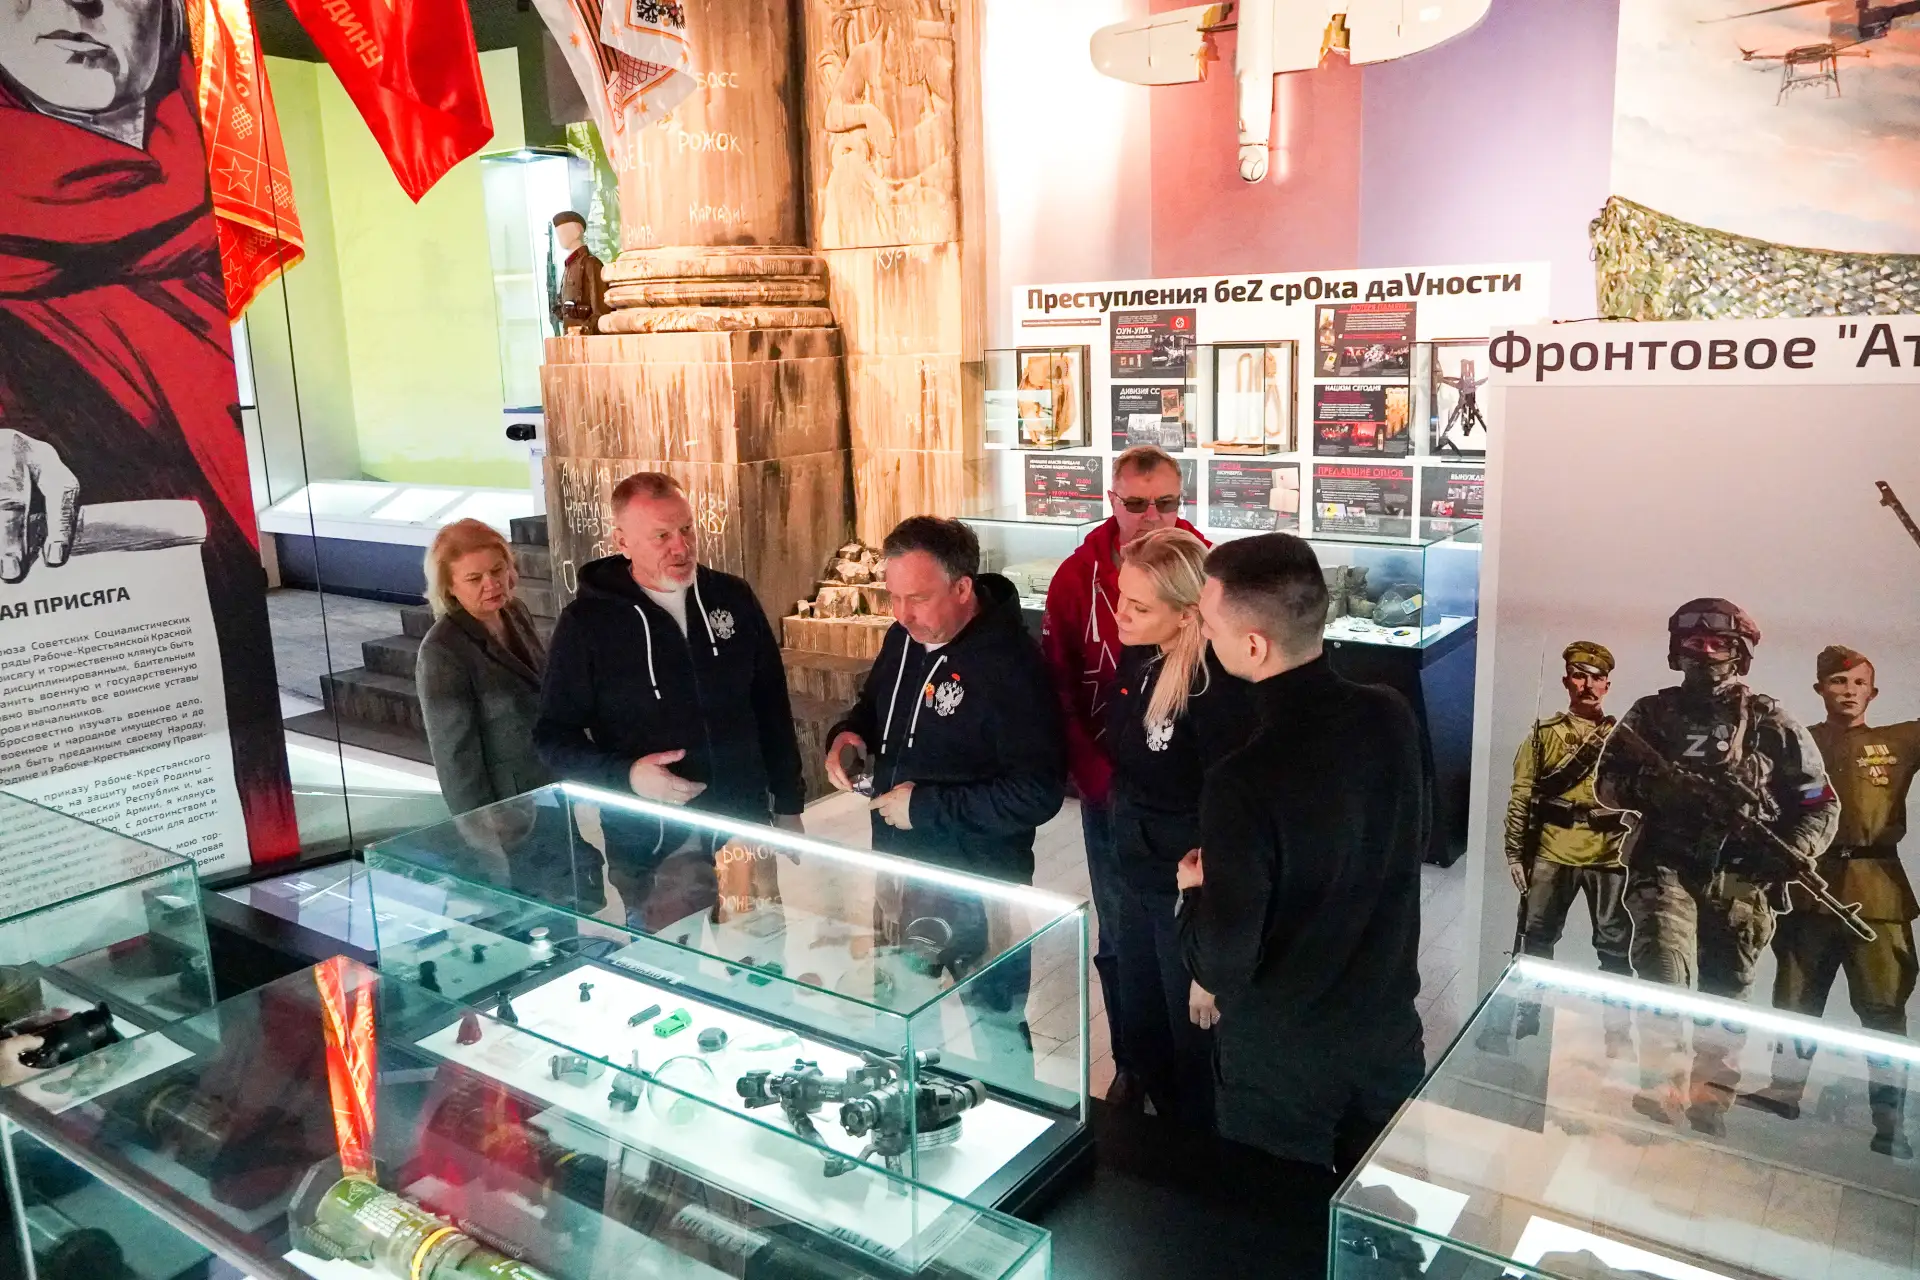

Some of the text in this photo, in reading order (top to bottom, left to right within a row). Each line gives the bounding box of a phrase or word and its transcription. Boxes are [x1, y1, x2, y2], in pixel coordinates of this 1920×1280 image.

[677, 130, 745, 155] РОЖОК
[1028, 272, 1521, 313] Преступления беZ срОка даVности
[1488, 330, 1816, 382] Фронтовое
[1318, 466, 1404, 477] ПРЕДАВШИЕ ОТЦОВ
[33, 586, 131, 615] ПРИСЯГА
[1, 626, 193, 670] ряды Рабоче-Крестьянской Красной
[31, 634, 90, 651] Советских
[94, 616, 191, 639] Социалистических
[48, 653, 125, 673] торжественно
[127, 645, 168, 658] клянусь
[170, 640, 195, 650] быть
[134, 651, 196, 669] бдительным
[27, 698, 87, 716] выполнять
[91, 693, 109, 702] все
[113, 682, 161, 698] воинские
[164, 674, 199, 688] уставы
[40, 685, 90, 701] военную
[106, 662, 198, 687] государственную
[65, 728, 117, 745] народное
[121, 715, 178, 732] имущество
[192, 708, 205, 718] до
[79, 716, 123, 731] изучать
[127, 704, 171, 720] военное
[26, 756, 54, 768] быть
[59, 740, 122, 761] преданным
[126, 730, 163, 744] своему
[167, 720, 206, 735] Народу,
[50, 740, 171, 774] Рабоче-Крестьянскому
[173, 732, 208, 745] Прави-
[43, 785, 89, 801] приказу
[94, 753, 211, 788] Рабоче-Крестьянского
[69, 799, 82, 807] на
[87, 787, 128, 803] защиту
[132, 777, 159, 790] моей
[163, 767, 202, 782] Родины
[126, 786, 180, 804] Республик
[197, 776, 215, 785] как
[125, 802, 162, 816] Армии,
[177, 788, 216, 802] клянусь
[136, 800, 207, 827] достоинством
[132, 825, 164, 839] жизни
[167, 820, 185, 829] для
[187, 810, 219, 824] дости-
[176, 838, 198, 849] мою
[202, 831, 223, 842] тор-
